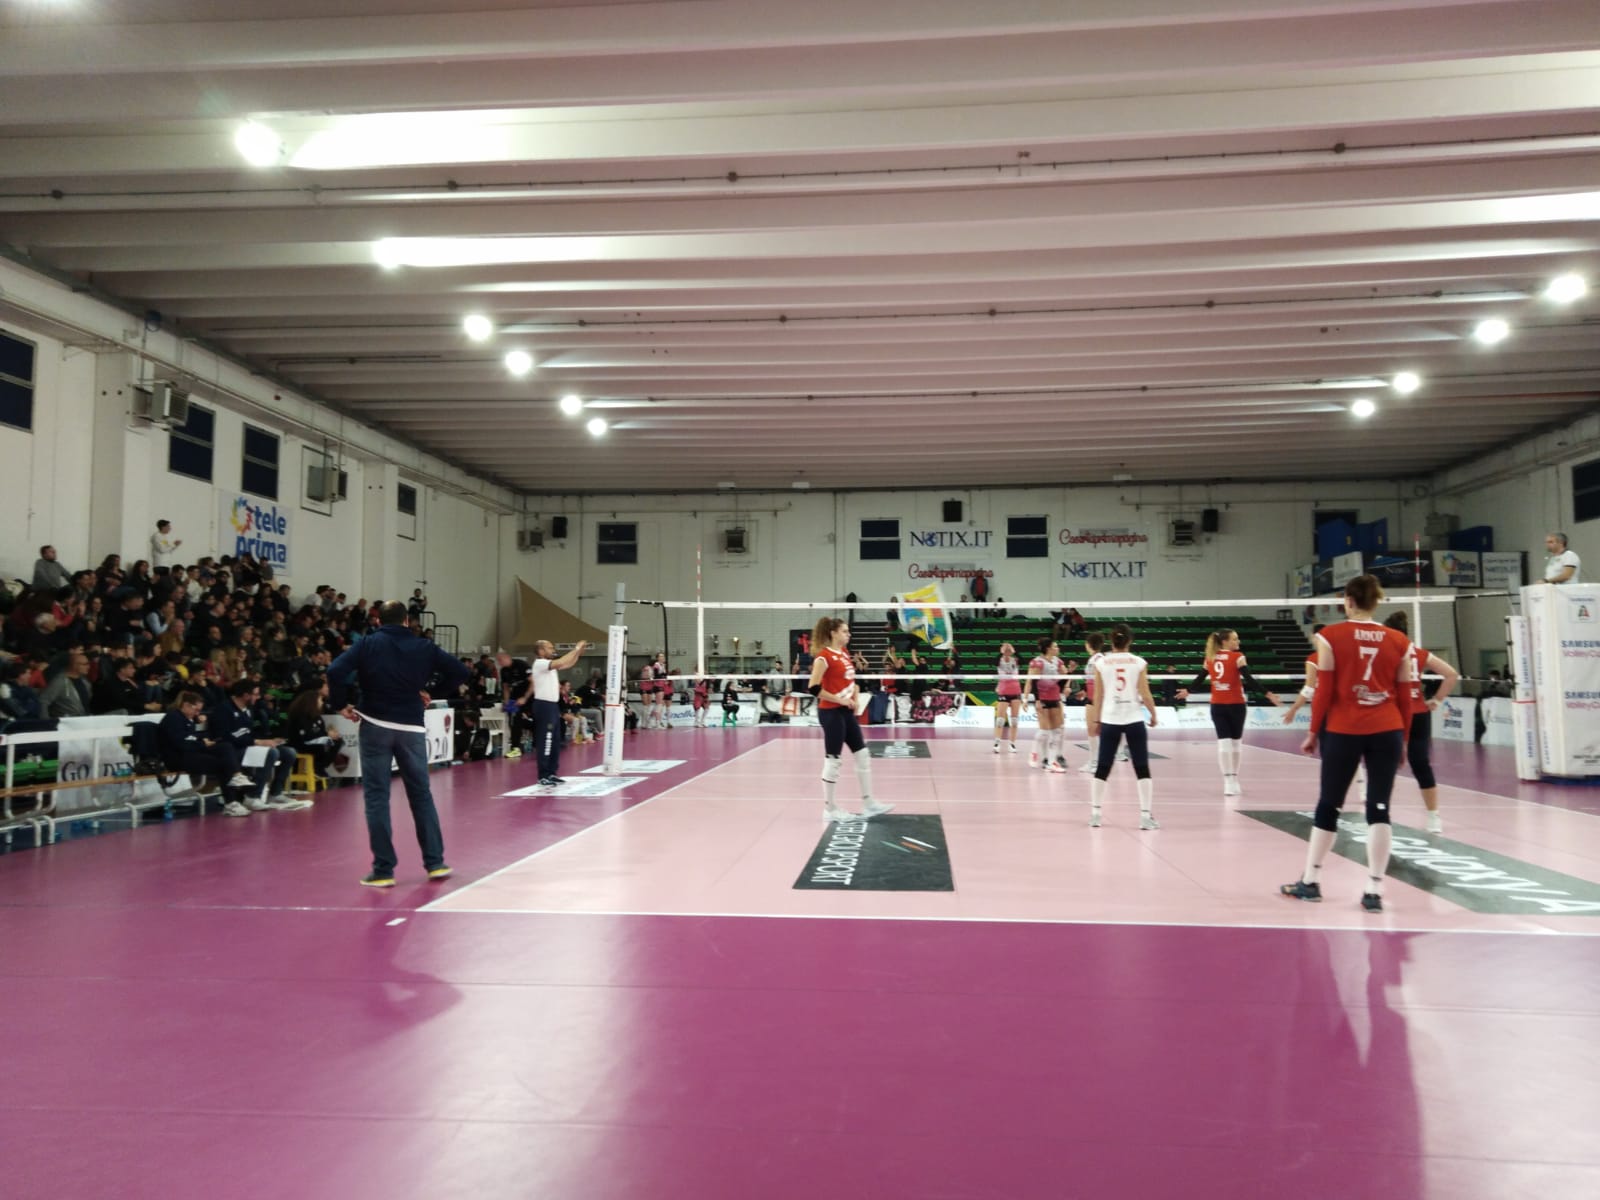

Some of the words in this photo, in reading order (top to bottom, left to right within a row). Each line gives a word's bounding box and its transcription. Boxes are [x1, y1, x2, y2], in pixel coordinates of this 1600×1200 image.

[254, 506, 286, 535] tele
[236, 532, 286, 563] prima
[1213, 661, 1225, 680] 9
[1359, 645, 1379, 681] 7
[1115, 668, 1127, 692] 5
